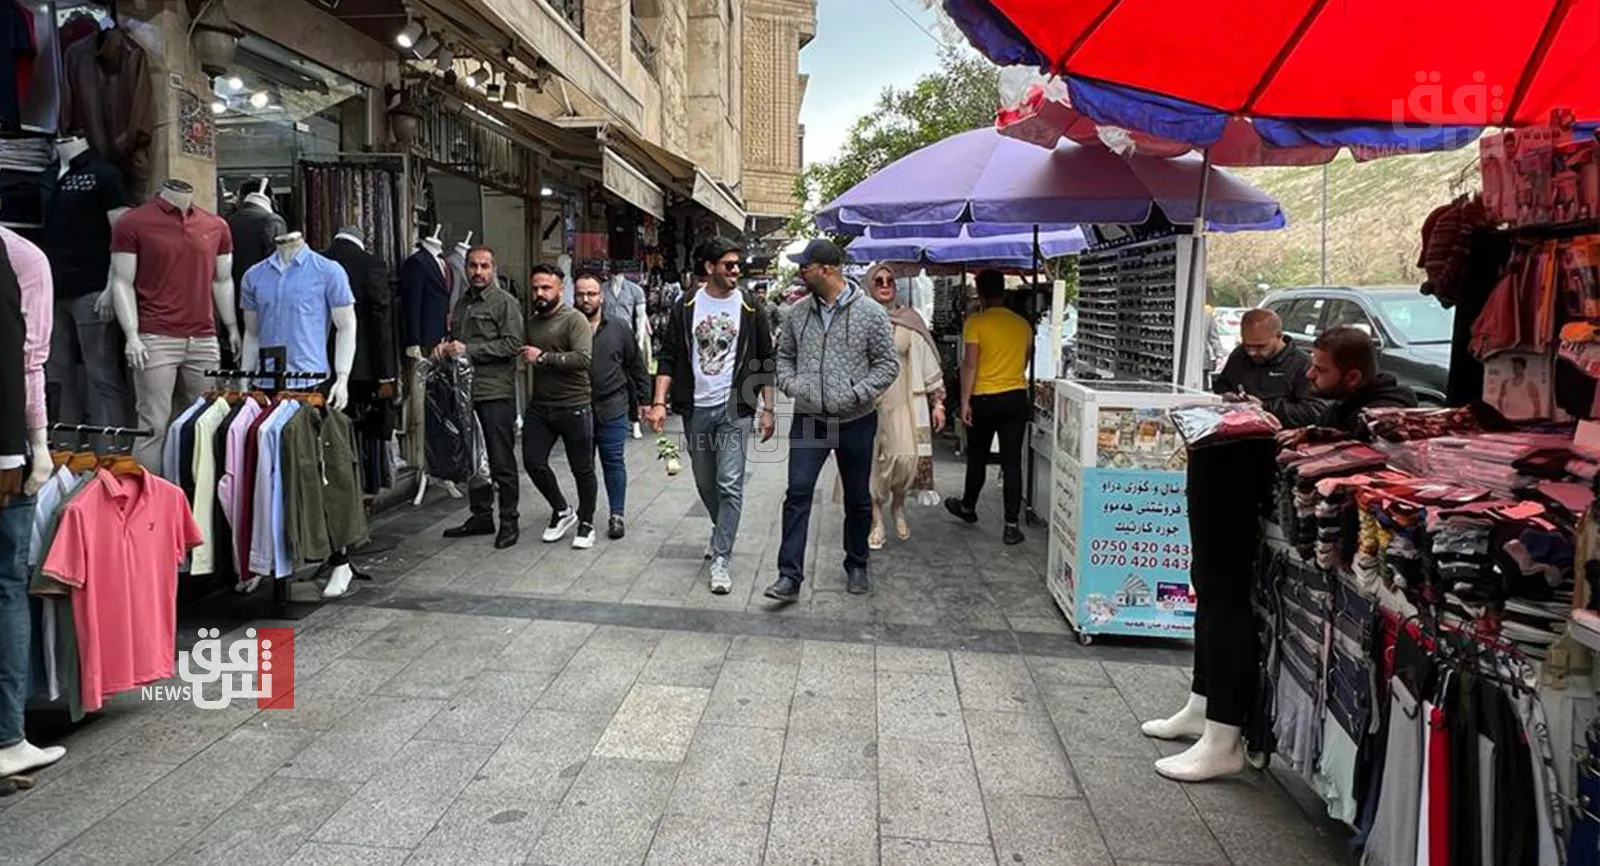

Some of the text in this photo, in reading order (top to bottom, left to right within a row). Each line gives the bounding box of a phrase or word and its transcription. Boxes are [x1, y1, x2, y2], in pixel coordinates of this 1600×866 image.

[1092, 539, 1189, 555] 0750 420 443
[1091, 553, 1189, 570] 0770 420 443
